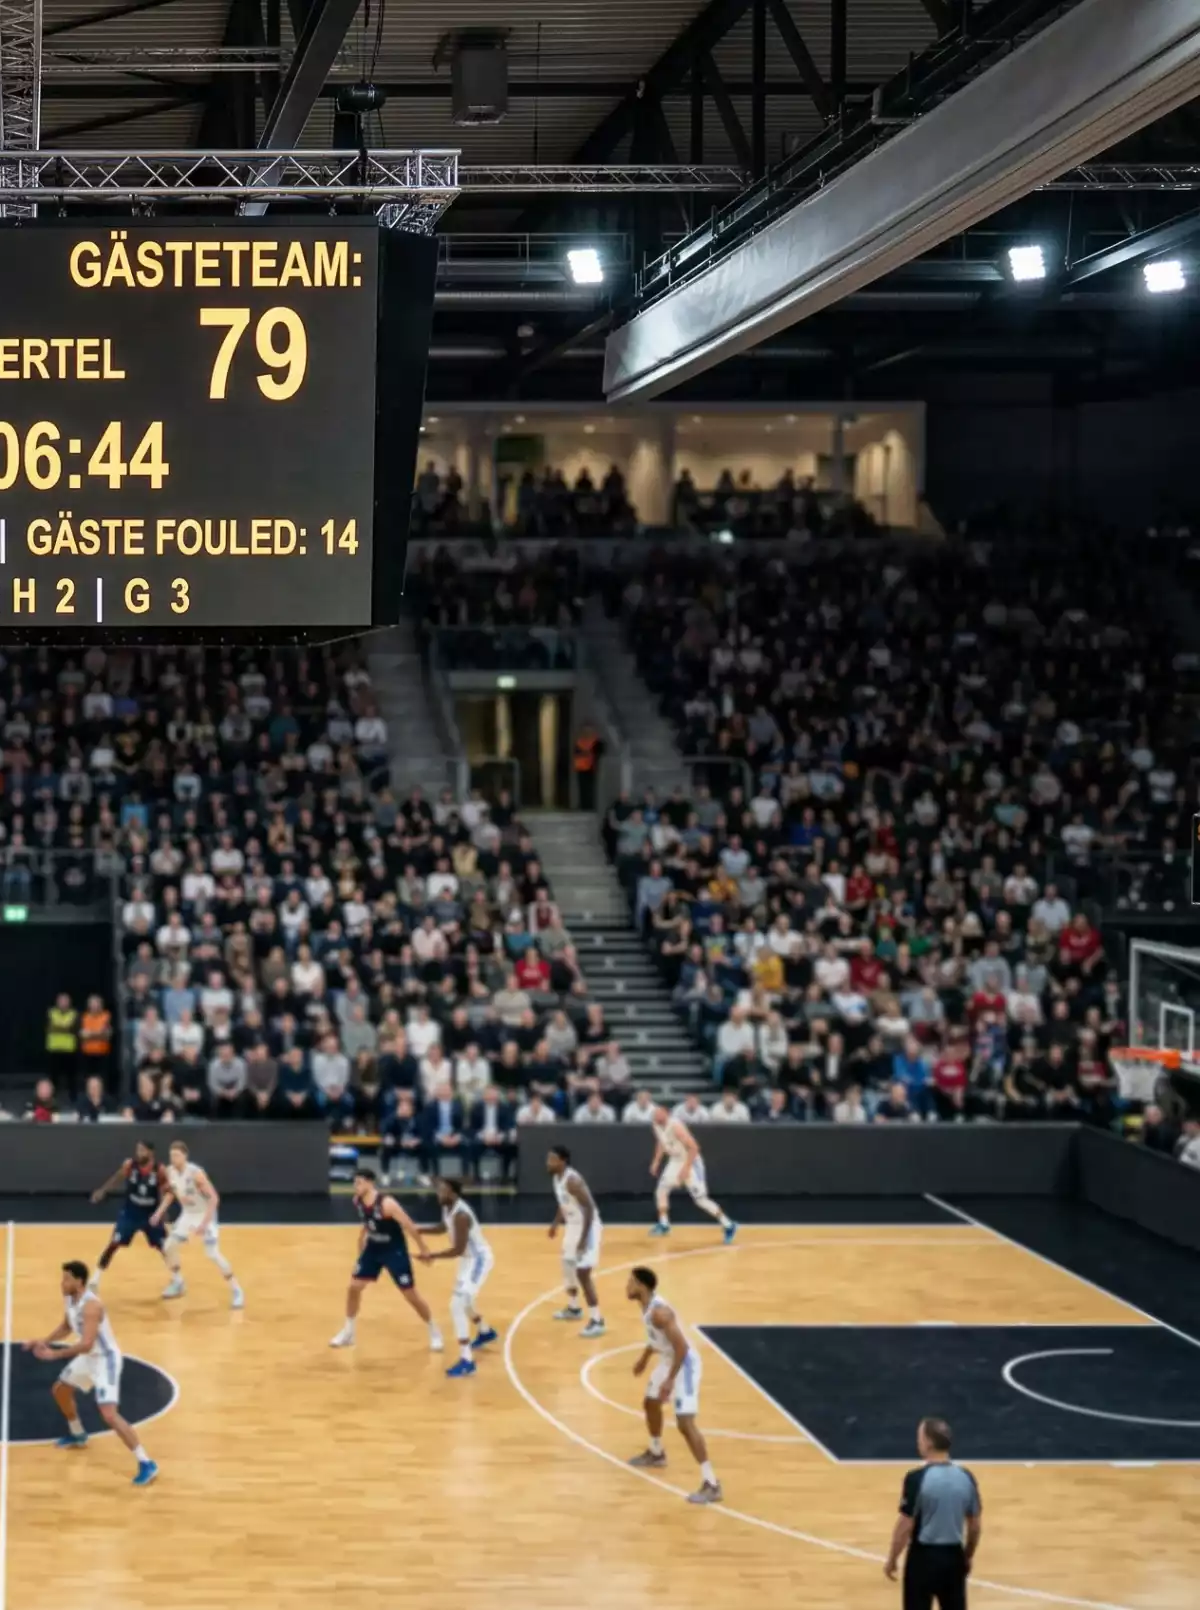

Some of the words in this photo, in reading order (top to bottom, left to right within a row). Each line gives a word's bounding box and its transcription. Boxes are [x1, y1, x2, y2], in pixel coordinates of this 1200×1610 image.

[70, 231, 362, 288] GÄSTETEAM:
[199, 306, 308, 402] 79
[26, 510, 145, 556] GÄSTE
[156, 518, 307, 556] FOULED:
[320, 518, 359, 556] 14
[13, 577, 36, 614] H
[55, 577, 75, 614] 2
[124, 577, 150, 614] G
[170, 577, 190, 614] 3
